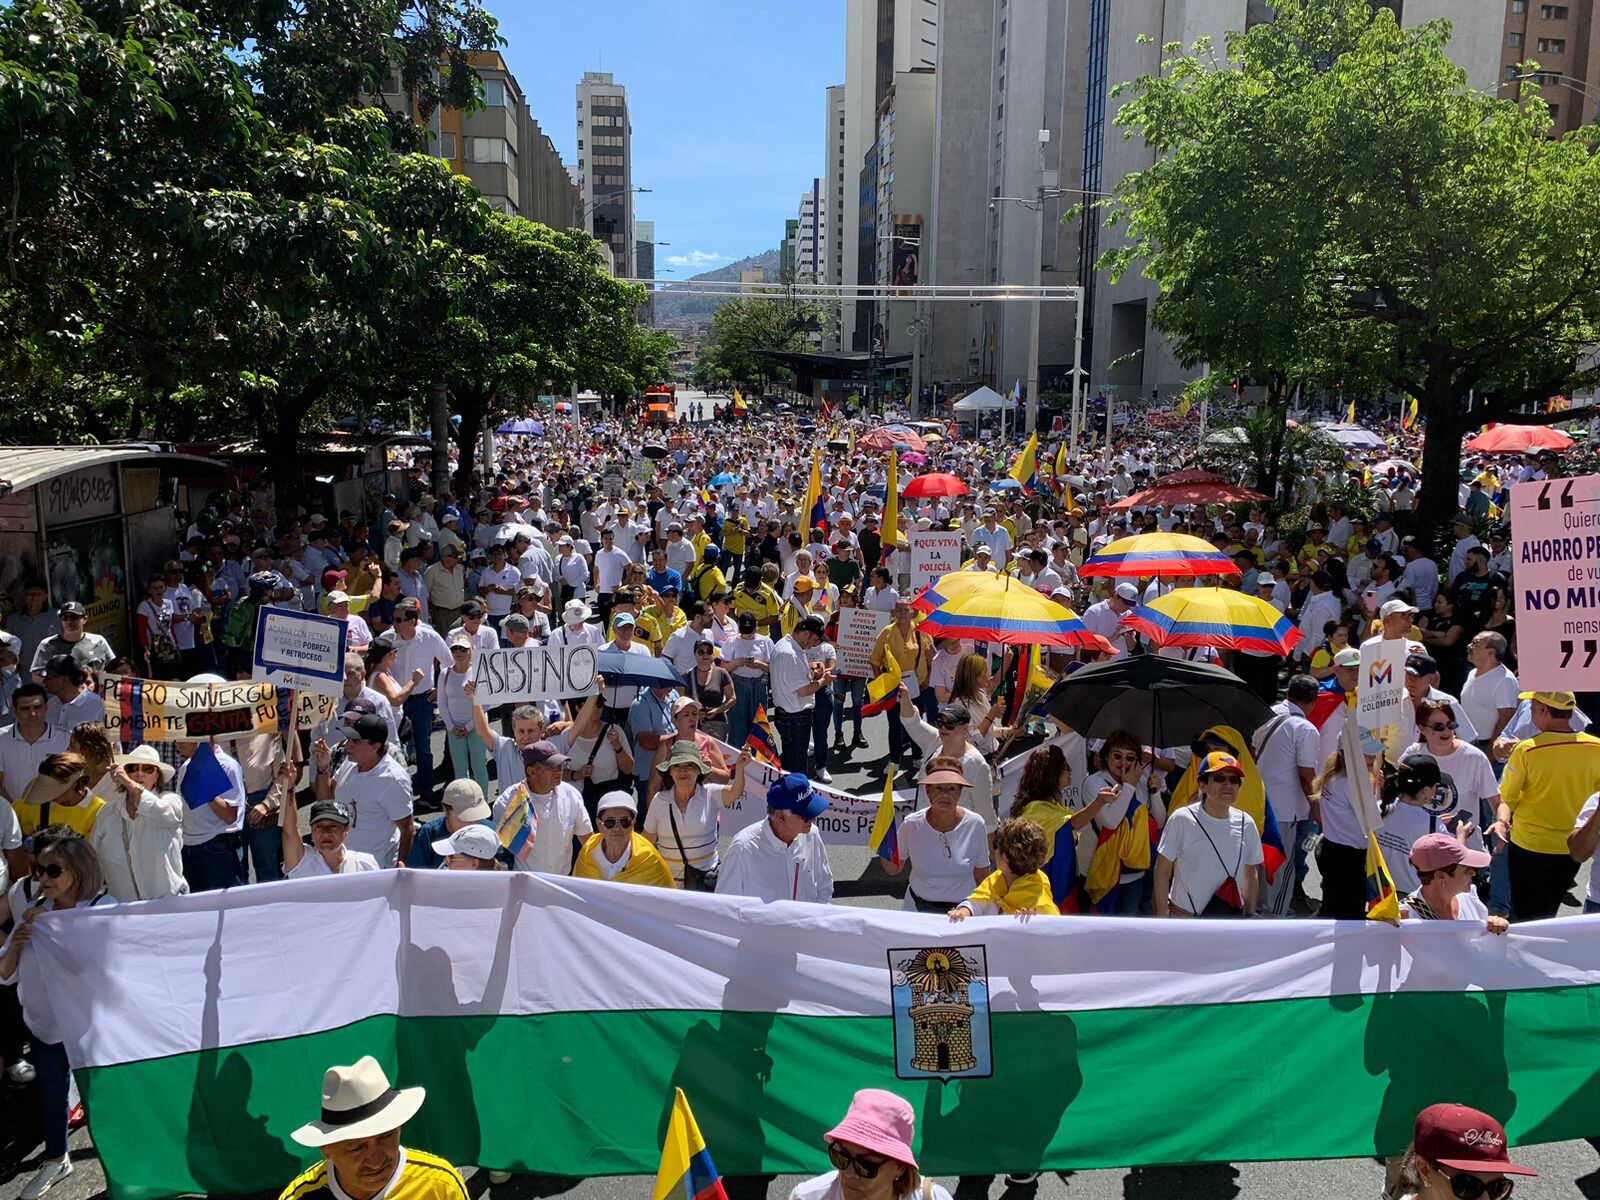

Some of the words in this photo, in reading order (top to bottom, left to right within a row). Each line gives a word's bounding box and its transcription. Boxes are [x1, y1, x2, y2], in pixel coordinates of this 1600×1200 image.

[938, 539, 958, 547] VIVA
[1521, 536, 1582, 564] AHORRO
[930, 551, 941, 560] LA
[1568, 564, 1583, 581] de
[1525, 588, 1560, 611] NO
[303, 641, 331, 653] POBREZA
[281, 648, 286, 656] Y
[286, 649, 323, 663] RETROCESO
[103, 678, 167, 706] PETRO
[1362, 697, 1399, 713] COLOMBIA
[163, 715, 184, 730] TE
